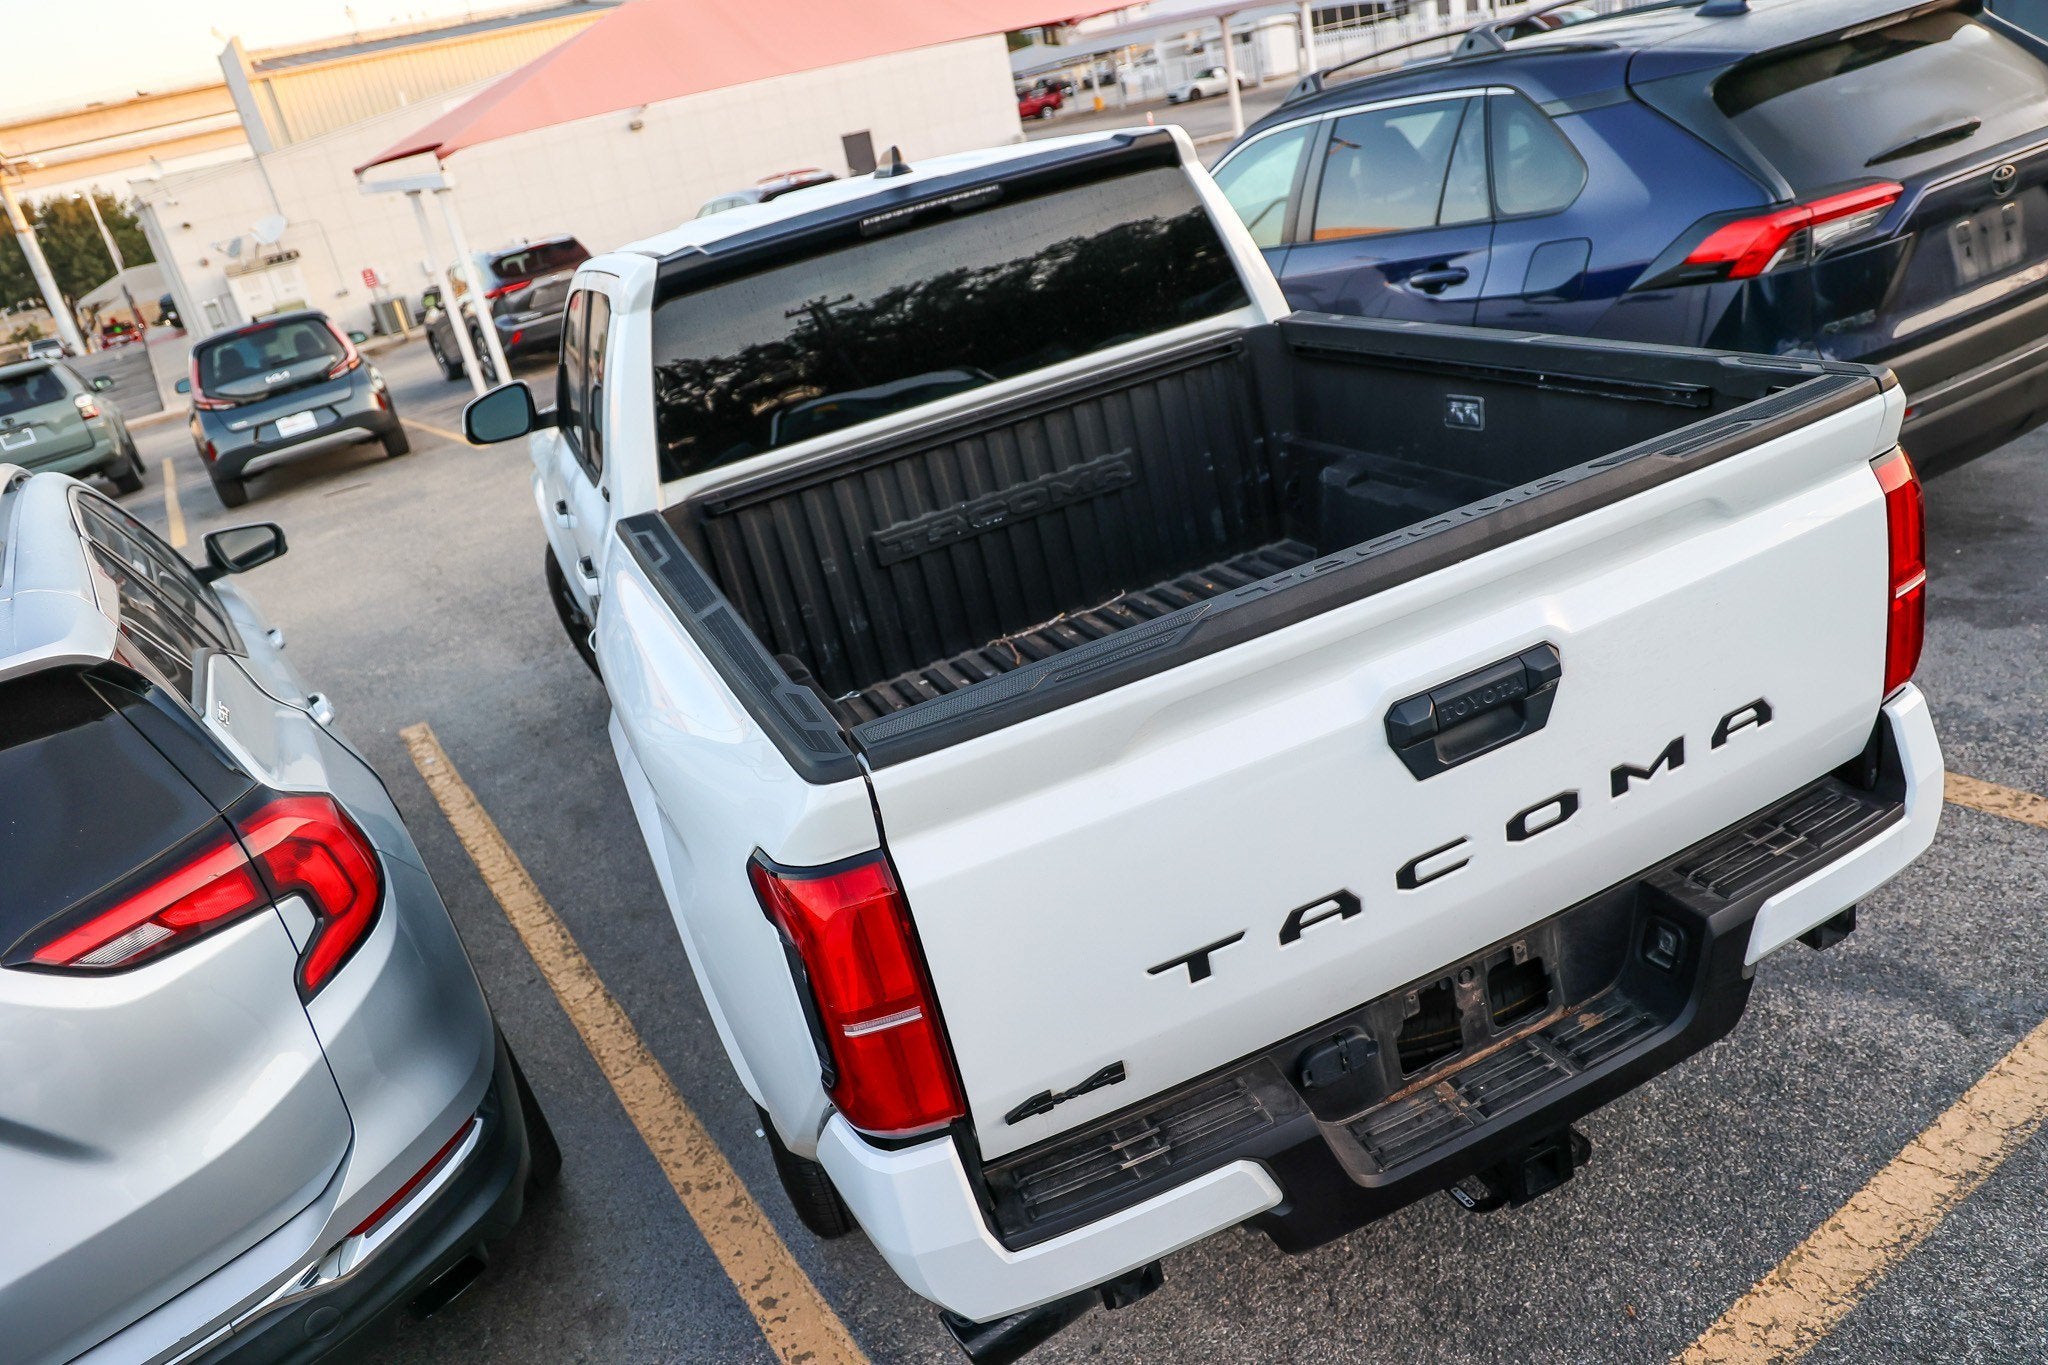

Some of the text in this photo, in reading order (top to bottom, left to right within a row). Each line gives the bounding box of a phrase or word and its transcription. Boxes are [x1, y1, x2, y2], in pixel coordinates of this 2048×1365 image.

[879, 459, 1133, 553] TACOMA
[1440, 676, 1525, 722] TOYOTA
[1146, 697, 1773, 984] TACOMA
